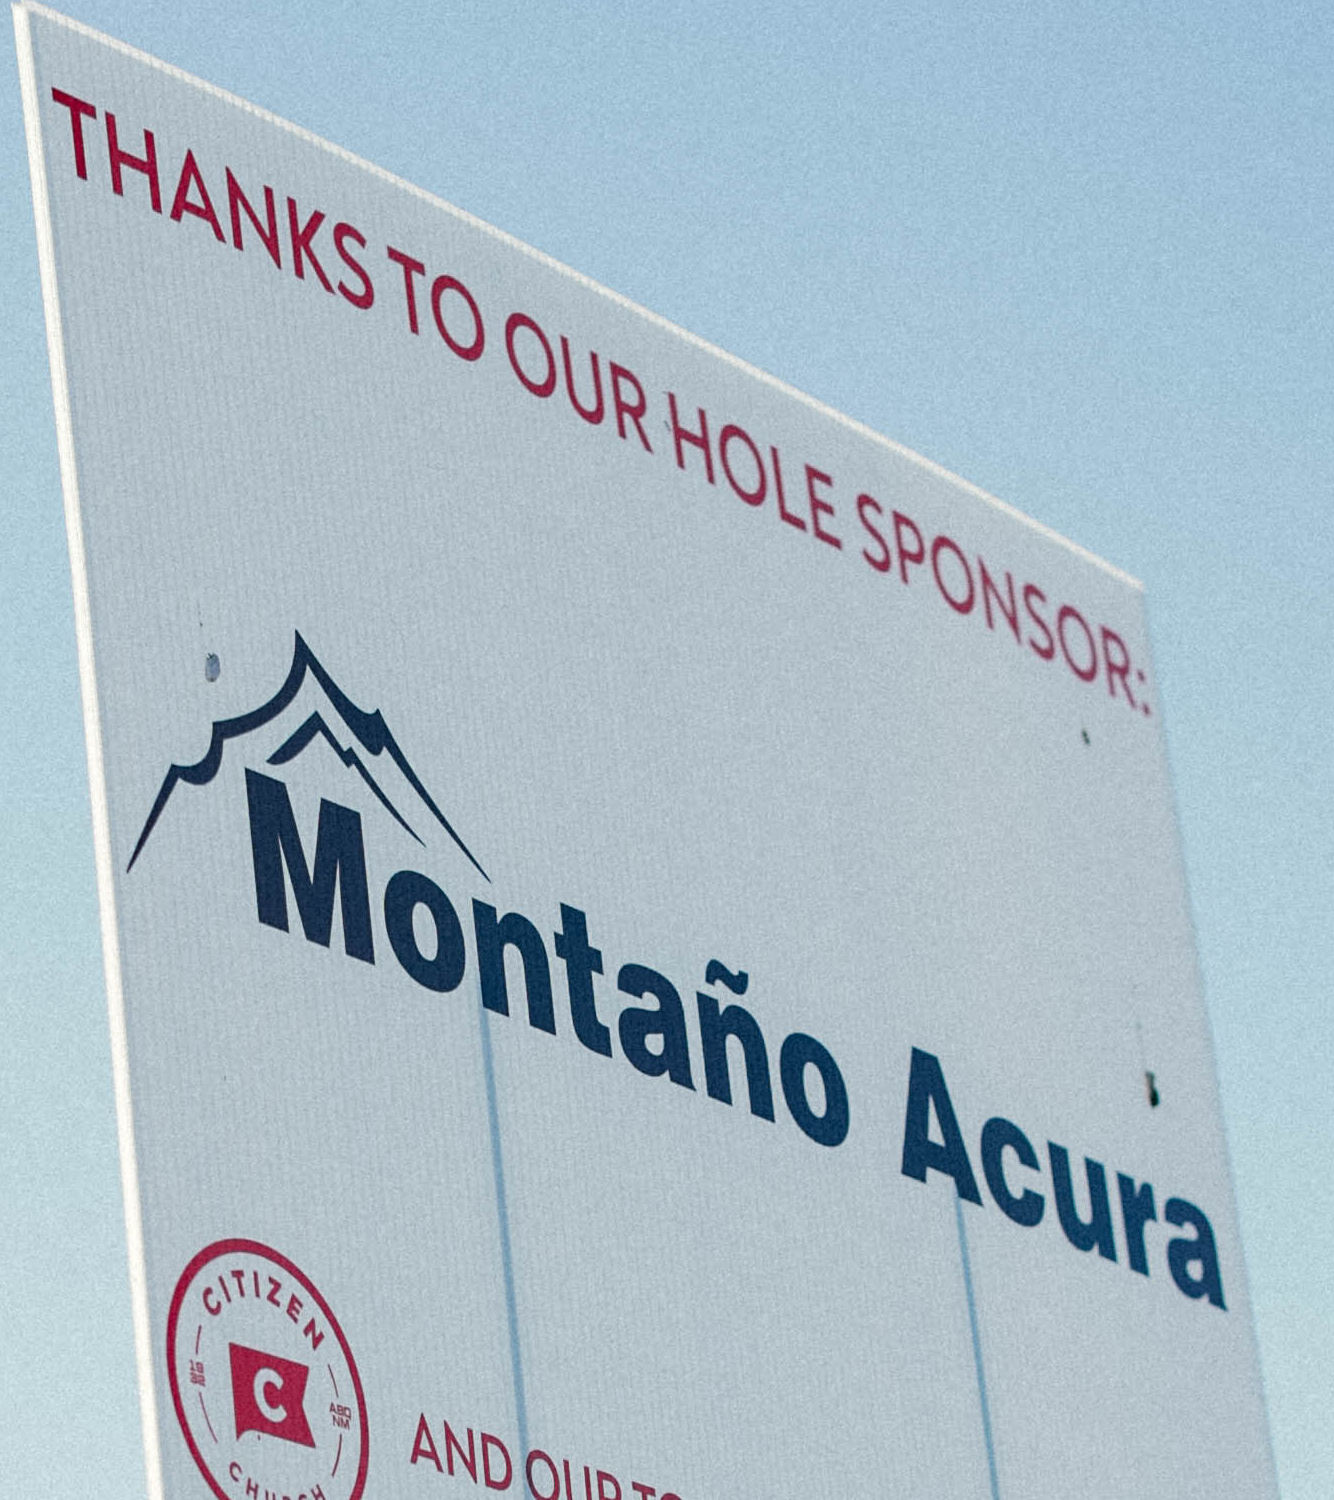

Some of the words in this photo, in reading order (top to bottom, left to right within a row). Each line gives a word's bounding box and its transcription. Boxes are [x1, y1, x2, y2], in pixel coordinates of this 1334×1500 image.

[51, 87, 375, 310] THANKS
[387, 246, 485, 361] TO
[505, 312, 653, 453] OUR
[668, 392, 842, 549] HOLE
[856, 493, 1152, 717] SPONSOR:
[244, 766, 851, 1149] Montaño
[900, 1046, 1228, 1312] Acura
[202, 1269, 325, 1350] CITIZEN
[253, 1367, 288, 1423] C
[332, 1416, 351, 1431] NM
[410, 1411, 514, 1491] AND
